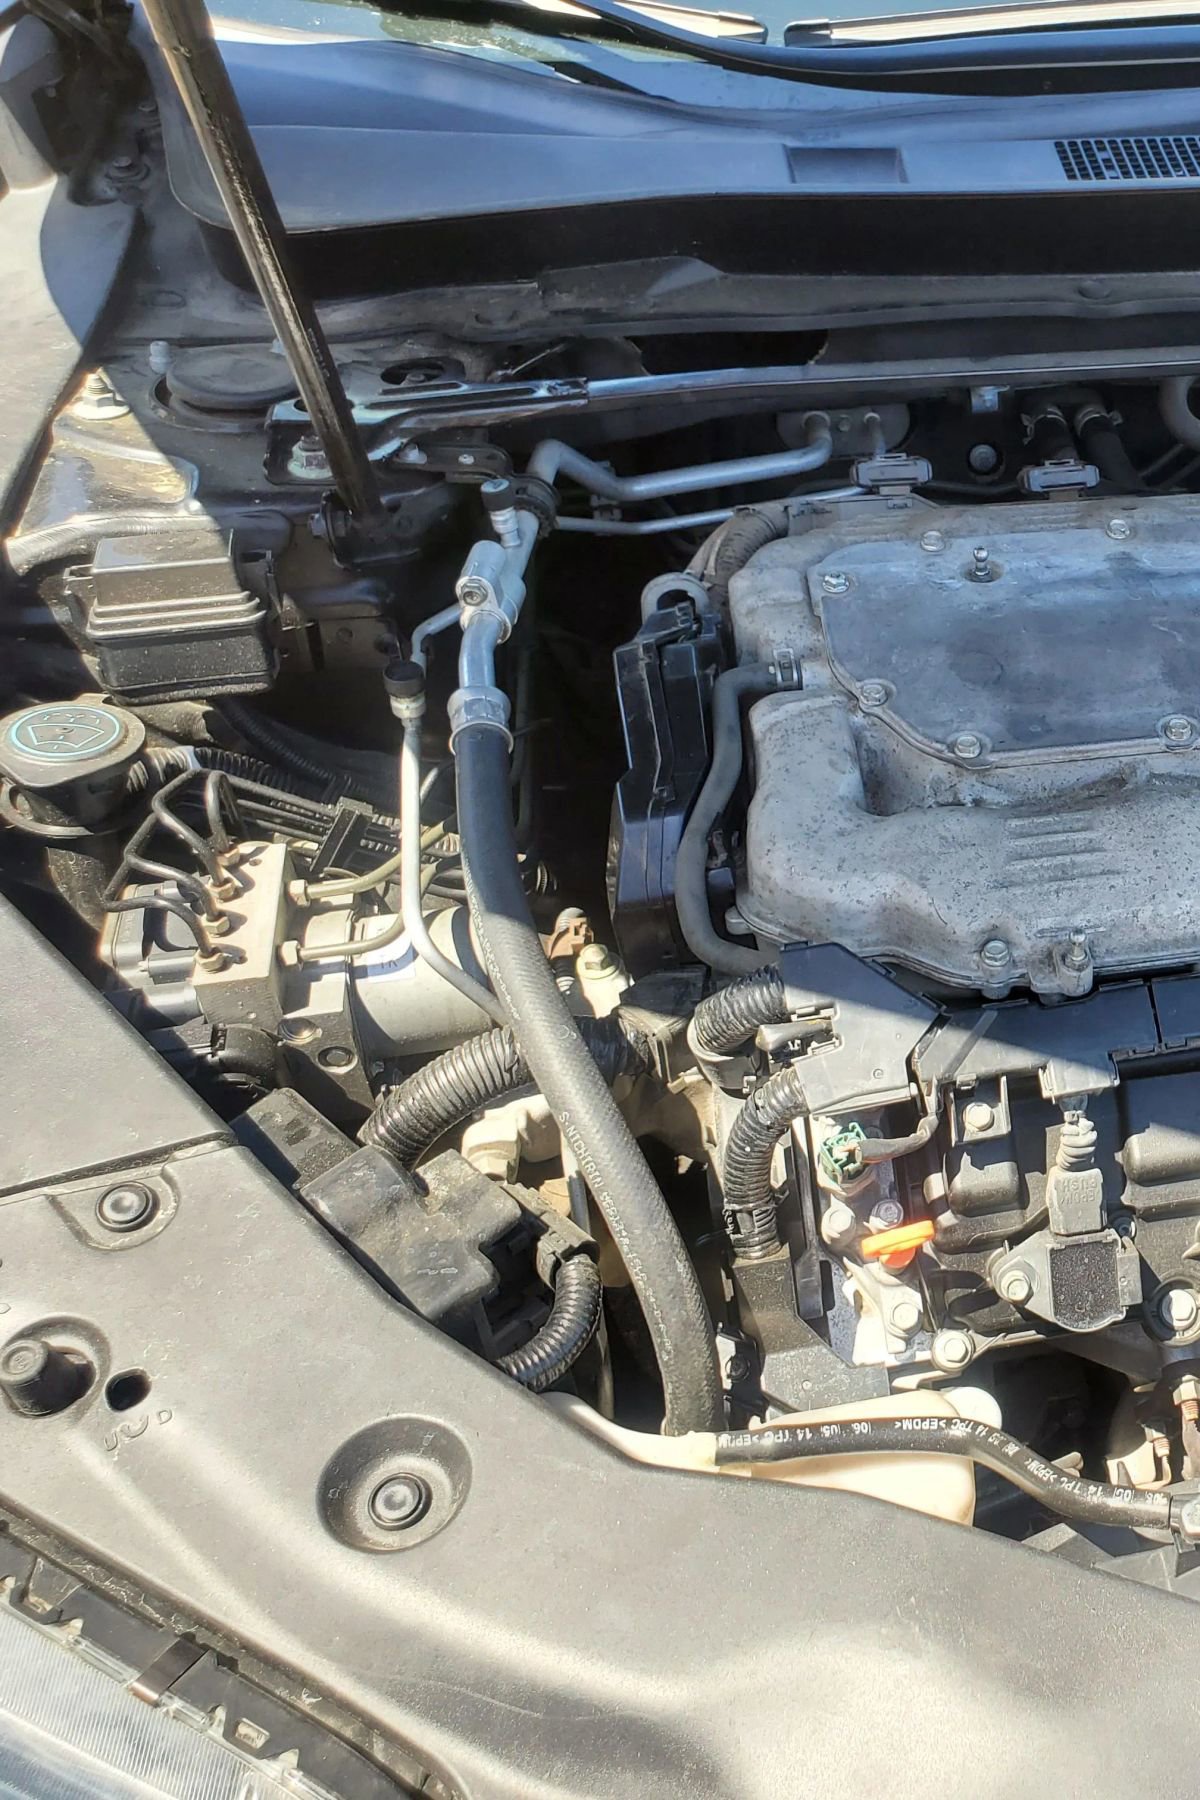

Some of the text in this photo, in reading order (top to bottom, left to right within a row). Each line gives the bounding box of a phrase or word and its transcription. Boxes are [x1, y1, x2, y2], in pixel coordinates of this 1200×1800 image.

[951, 1418, 974, 1433] TPC
[796, 1427, 812, 1441] 14
[1060, 1477, 1082, 1494] TPC
